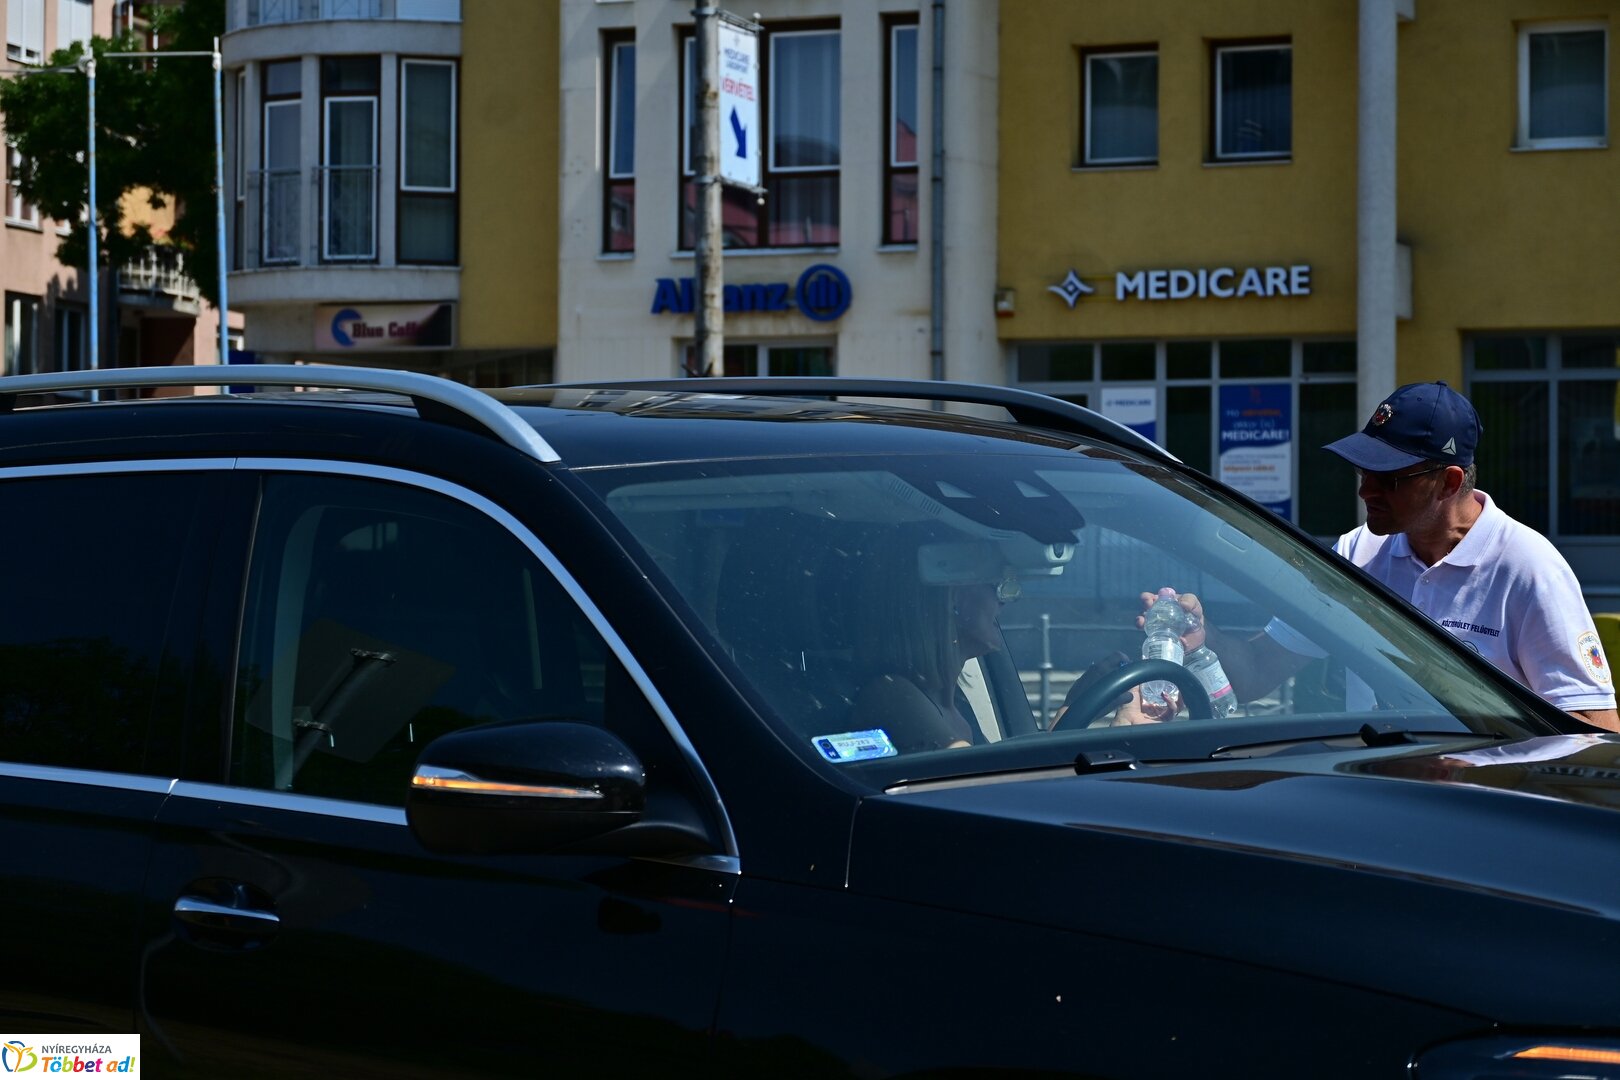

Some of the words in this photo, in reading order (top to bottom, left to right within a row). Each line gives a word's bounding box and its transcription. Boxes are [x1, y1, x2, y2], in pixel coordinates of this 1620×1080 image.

[1115, 265, 1311, 301] MEDICARE
[352, 322, 384, 339] Blue
[1222, 429, 1290, 442] MEDICARE!
